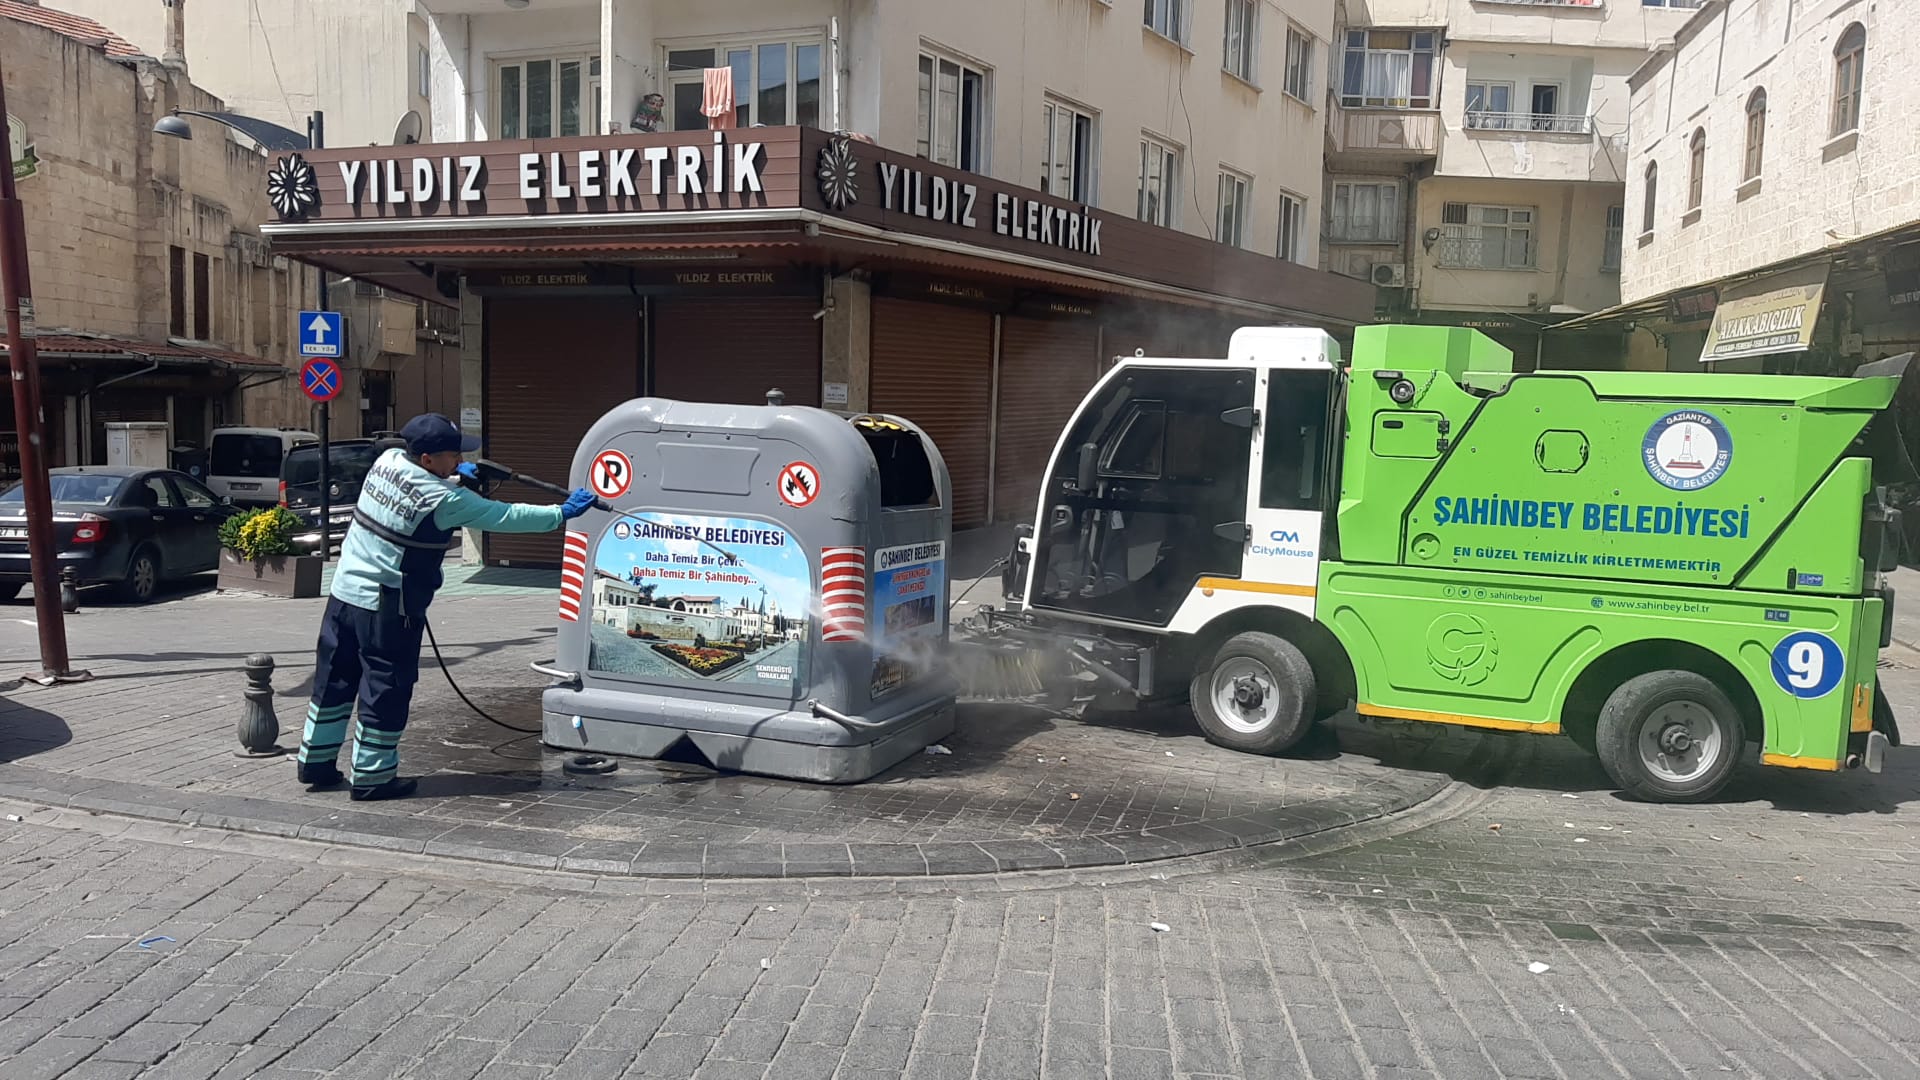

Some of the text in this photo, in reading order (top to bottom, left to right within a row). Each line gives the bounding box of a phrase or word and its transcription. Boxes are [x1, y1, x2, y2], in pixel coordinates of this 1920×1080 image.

[338, 131, 763, 204] YILDIZ ELEKTRİK
[879, 161, 1102, 256] YILDIZ ELEKTRİK
[500, 273, 588, 285] YILDIZ ELEKTRİK
[675, 270, 774, 284] YILDIZ ELEKTRİK
[1666, 412, 1712, 425] GAZİANTEP
[1645, 447, 1679, 488] ŞAHİNBEY
[1433, 493, 1749, 539] ŞAHİNBEY BELEDİYESİ
[645, 551, 669, 563] Daha
[672, 553, 698, 564] Temiz
[701, 554, 715, 565] Bir
[1252, 545, 1314, 558] CityMouse
[1453, 546, 1721, 573] EN GÜZEL TEMİZLİK KİRLETMEMEKTİR
[633, 566, 757, 585] Daha Temiz Bir Şahinbey...
[1489, 590, 1544, 603] sahinbeybel
[1608, 599, 1710, 614] www.sahinbey.bel.tr
[1788, 641, 1824, 689] 9
